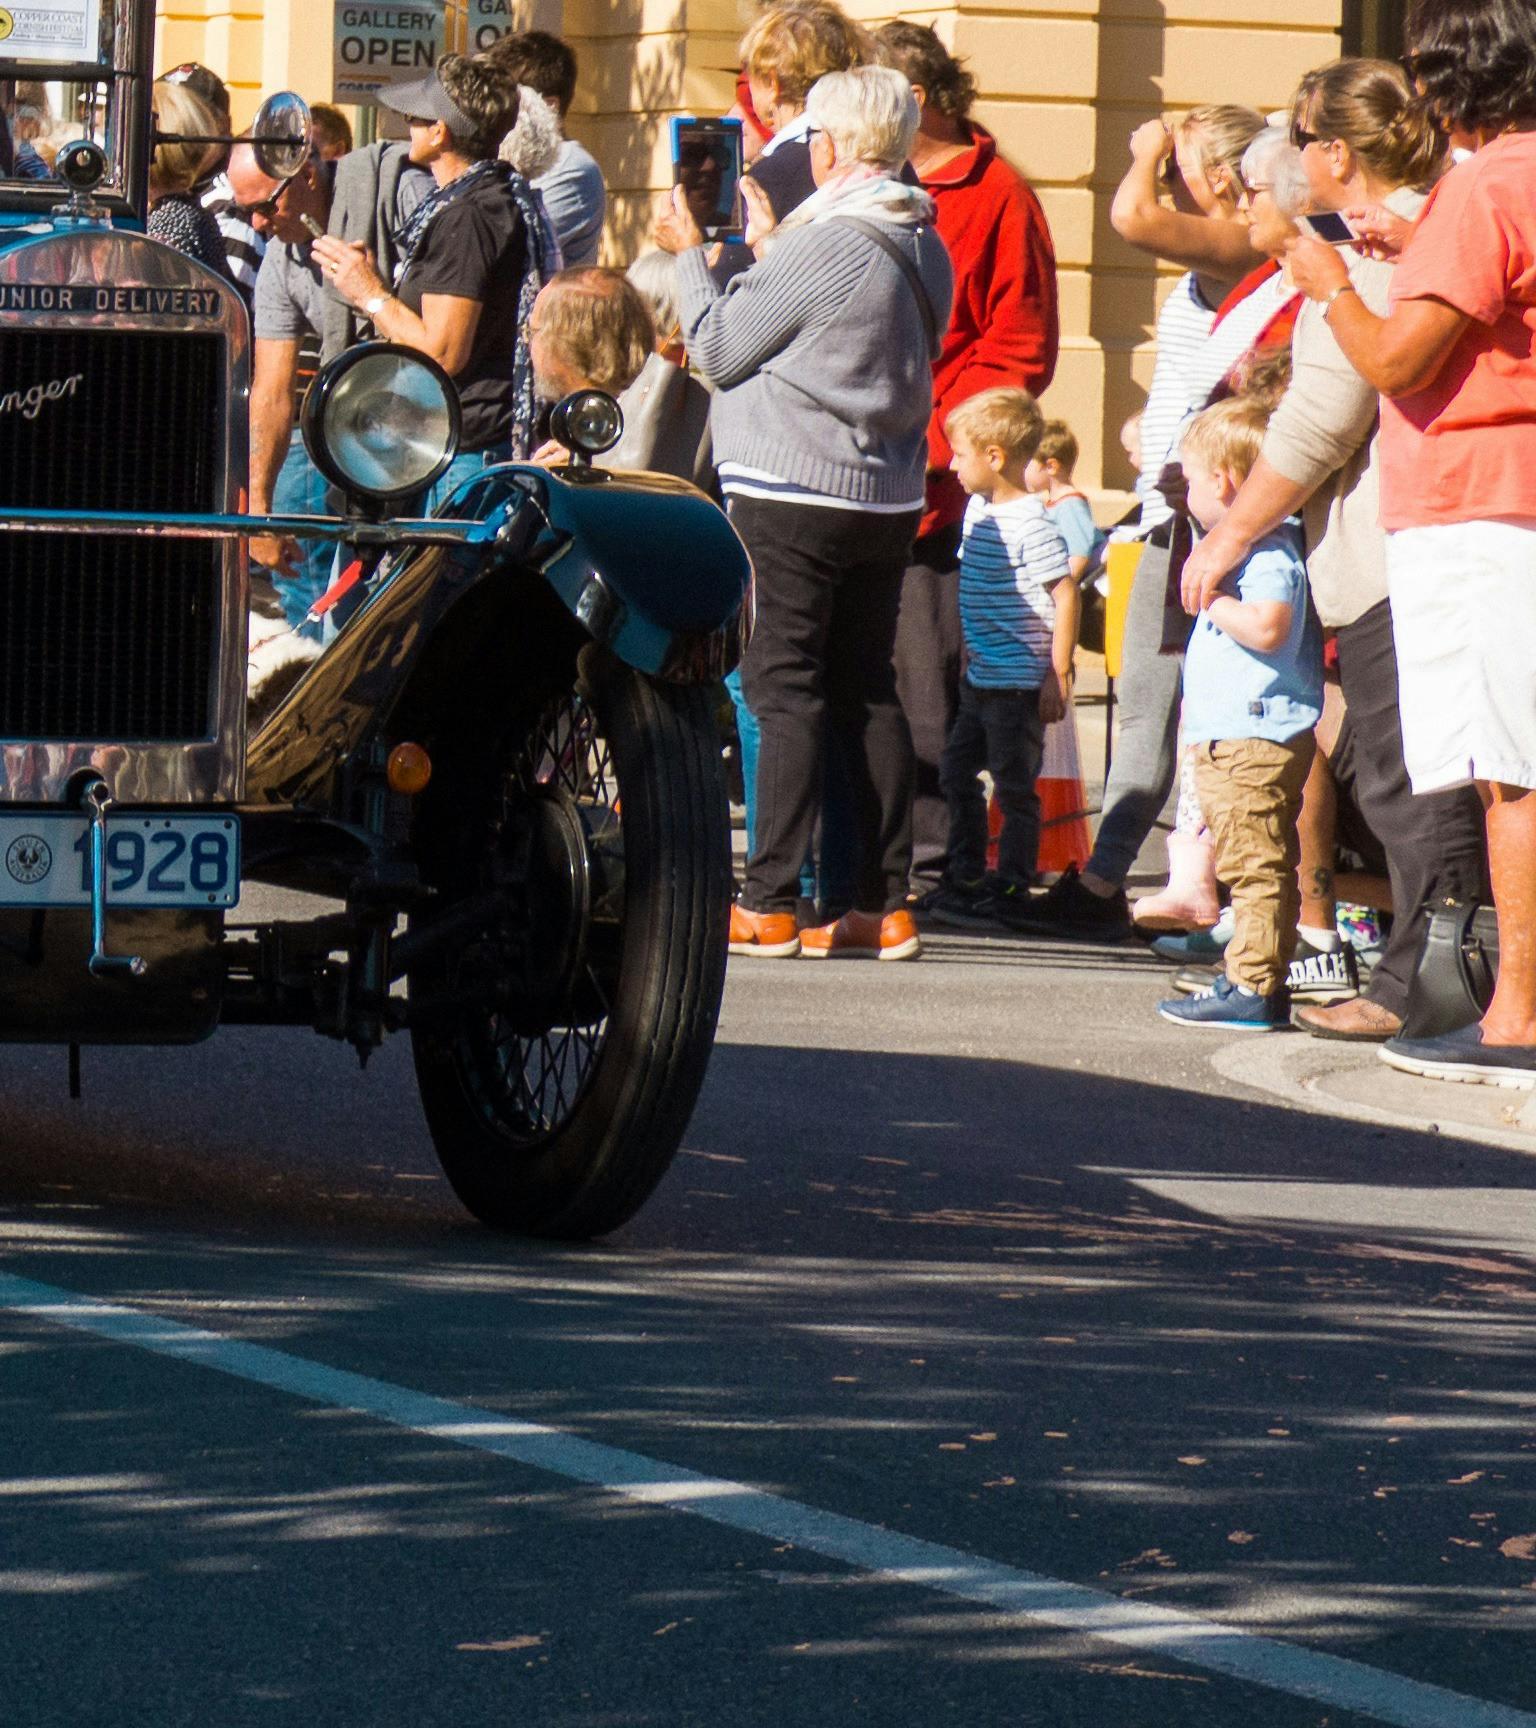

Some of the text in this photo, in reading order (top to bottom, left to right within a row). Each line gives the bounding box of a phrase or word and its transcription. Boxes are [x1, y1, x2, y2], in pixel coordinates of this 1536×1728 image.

[342, 9, 436, 30] GALLERY
[341, 36, 435, 68] OPEN
[96, 288, 216, 314] DELIVERY
[73, 831, 229, 892] 1928
